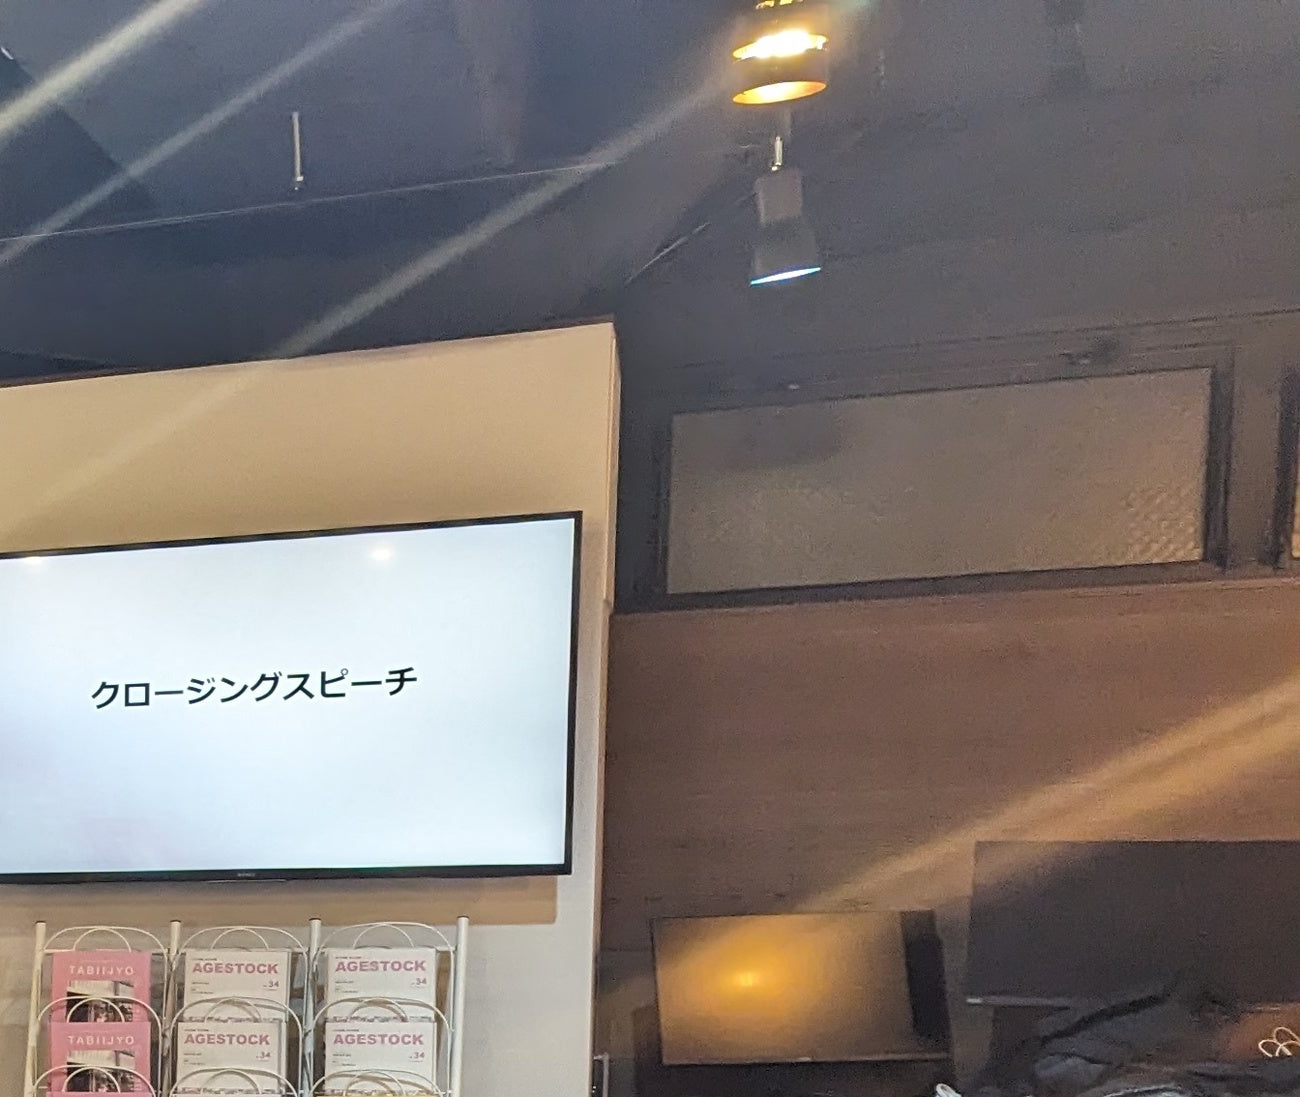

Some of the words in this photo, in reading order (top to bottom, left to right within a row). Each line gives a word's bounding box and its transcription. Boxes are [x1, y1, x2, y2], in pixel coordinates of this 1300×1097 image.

[91, 666, 418, 710] クロージングスピーチ
[192, 962, 279, 975] AGESTOCK
[335, 960, 426, 972] AGESTOCK
[183, 1033, 270, 1046] AGESTOCK
[333, 1033, 424, 1046] AGESTOCK
